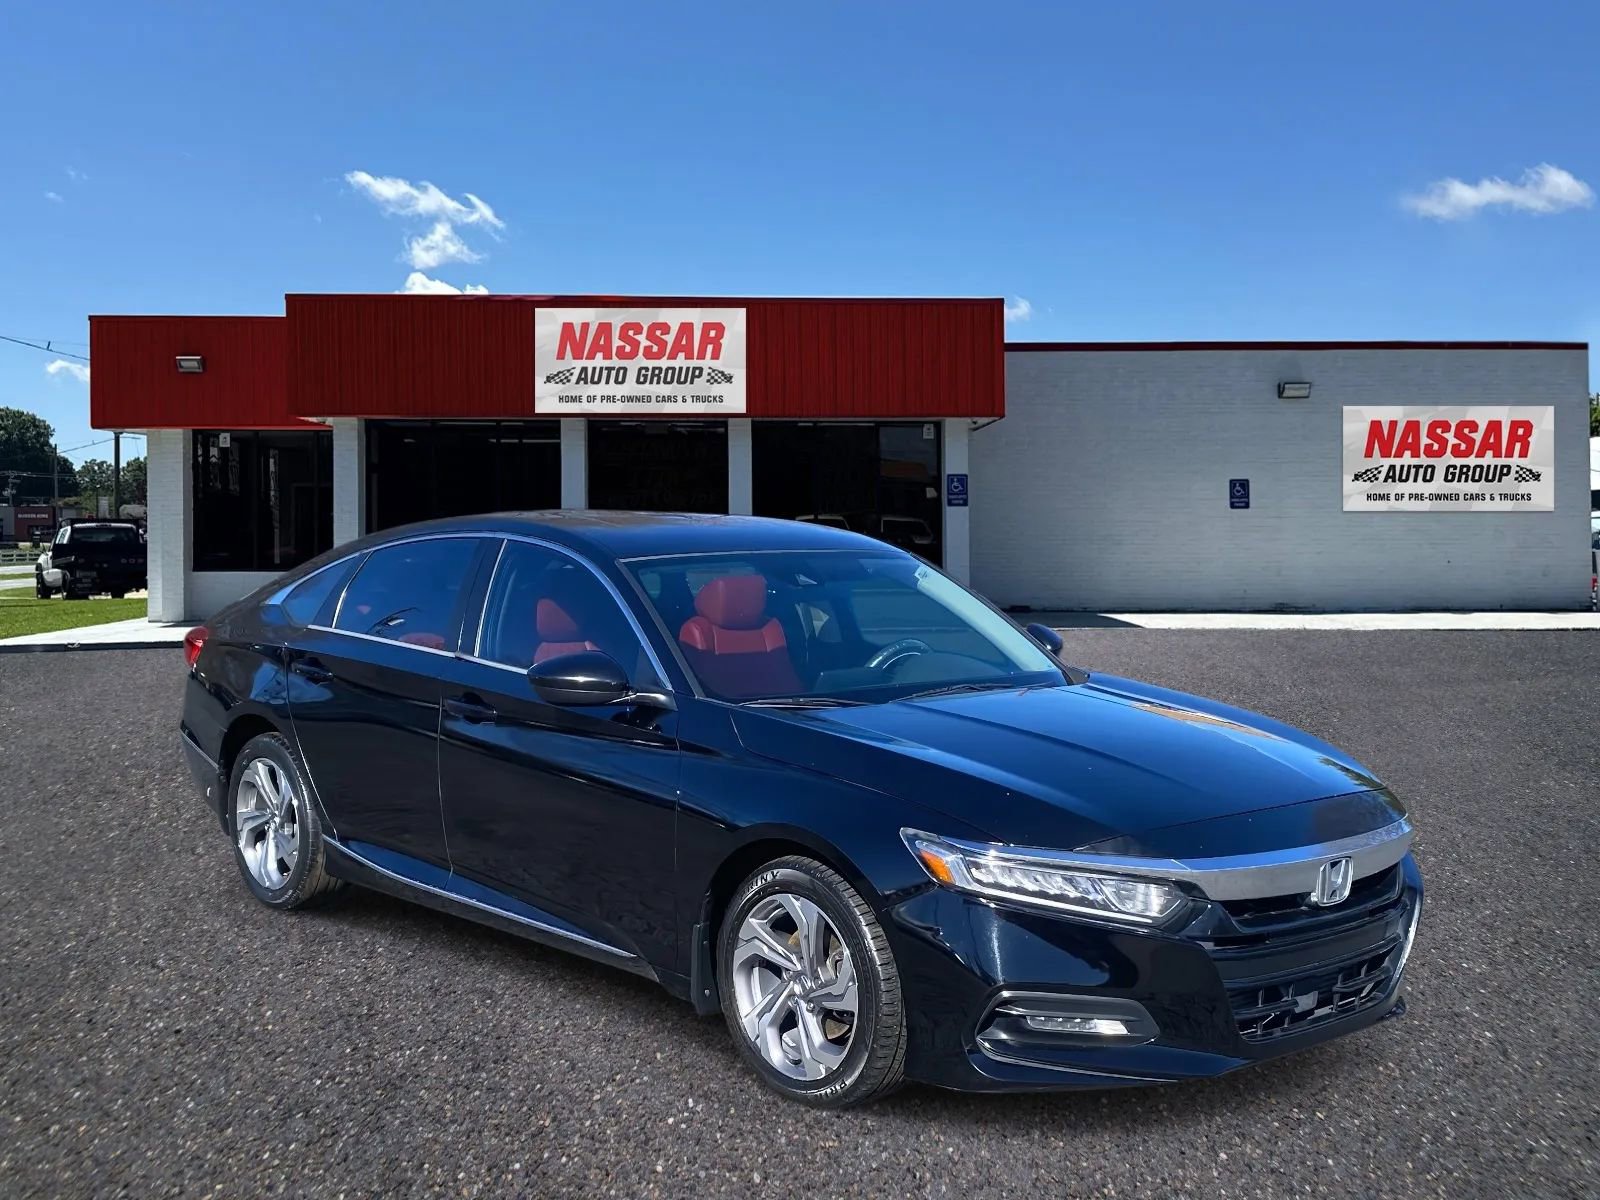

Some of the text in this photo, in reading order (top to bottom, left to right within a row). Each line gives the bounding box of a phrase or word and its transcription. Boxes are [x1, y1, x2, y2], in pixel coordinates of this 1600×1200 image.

[556, 322, 726, 361] NASSAR
[575, 366, 704, 385] AUTO GROUP
[558, 394, 724, 404] HOME OF PRE-OWNED CARS & TRUCKS
[1364, 419, 1534, 459] NASSAR
[1383, 464, 1513, 483] AUTO GROUP
[1366, 492, 1532, 502] HOME OF PRE-OWNED CARS & TRUCKS
